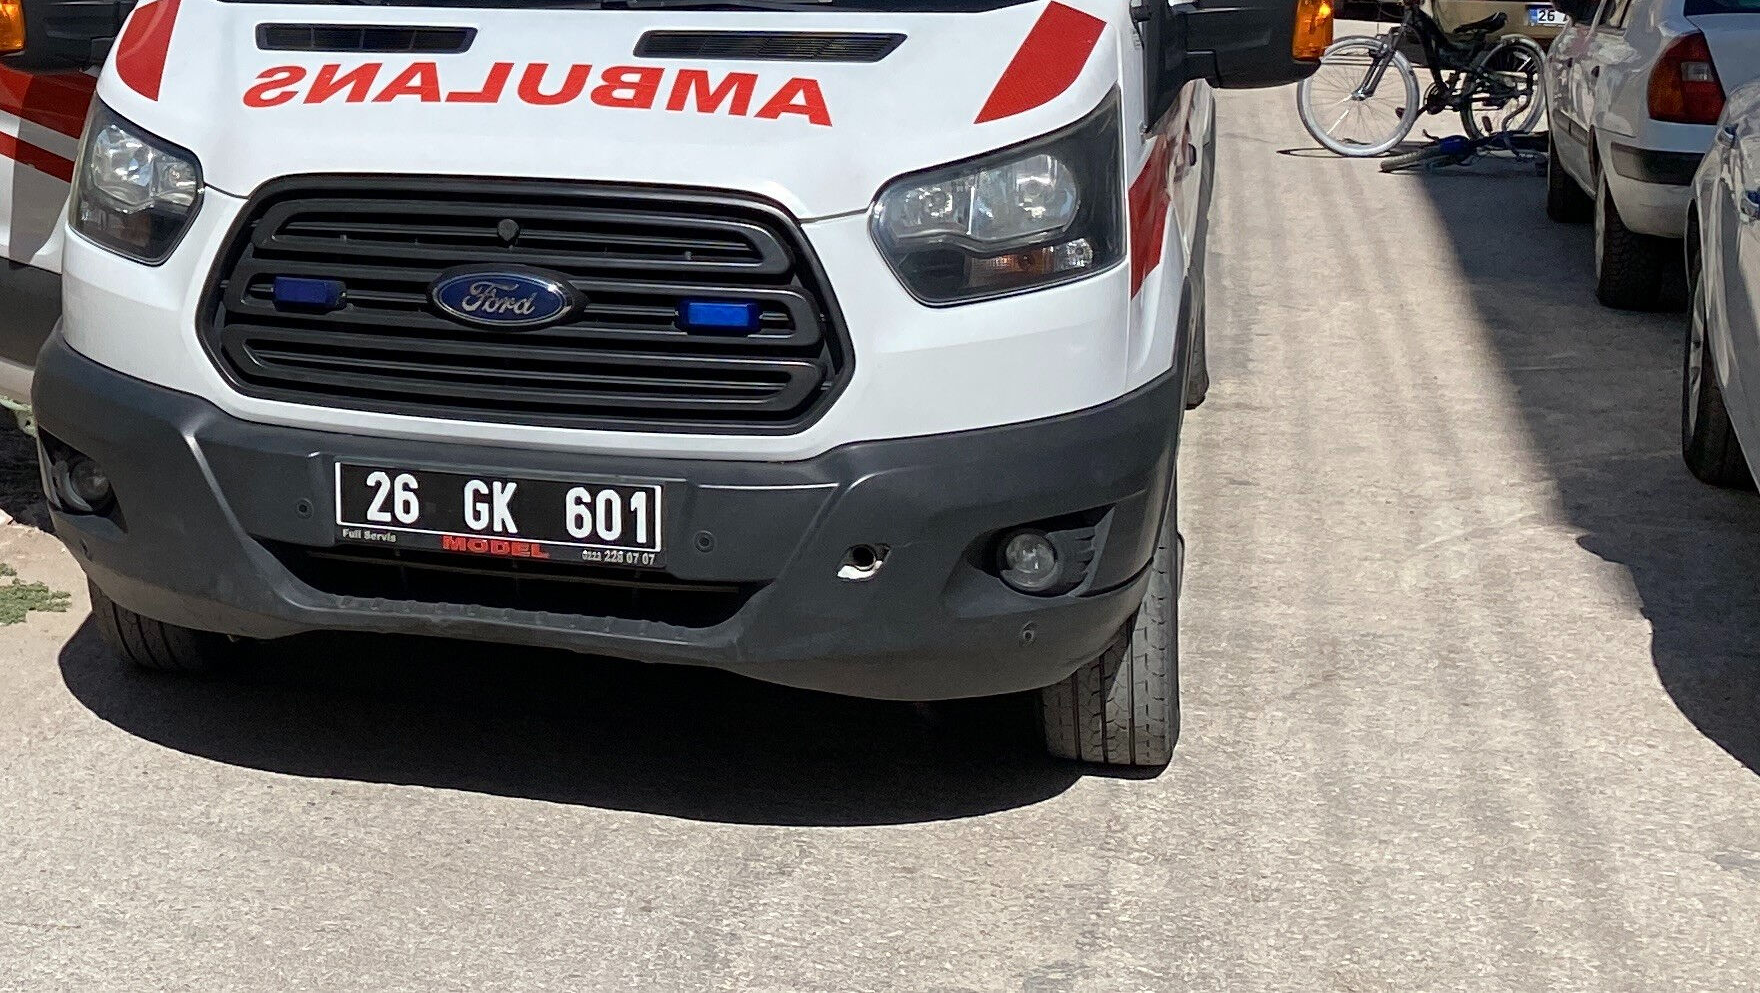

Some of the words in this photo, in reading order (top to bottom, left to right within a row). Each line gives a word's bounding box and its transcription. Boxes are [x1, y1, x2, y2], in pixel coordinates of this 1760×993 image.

[1539, 9, 1555, 21] 26
[462, 281, 538, 315] Ford
[366, 471, 420, 524] 26
[464, 479, 518, 534] GK
[565, 486, 647, 544] 601
[342, 528, 362, 539] Full
[364, 530, 397, 543] Servis
[442, 534, 550, 559] MODEL
[626, 551, 640, 565] 07
[642, 552, 656, 566] 07
